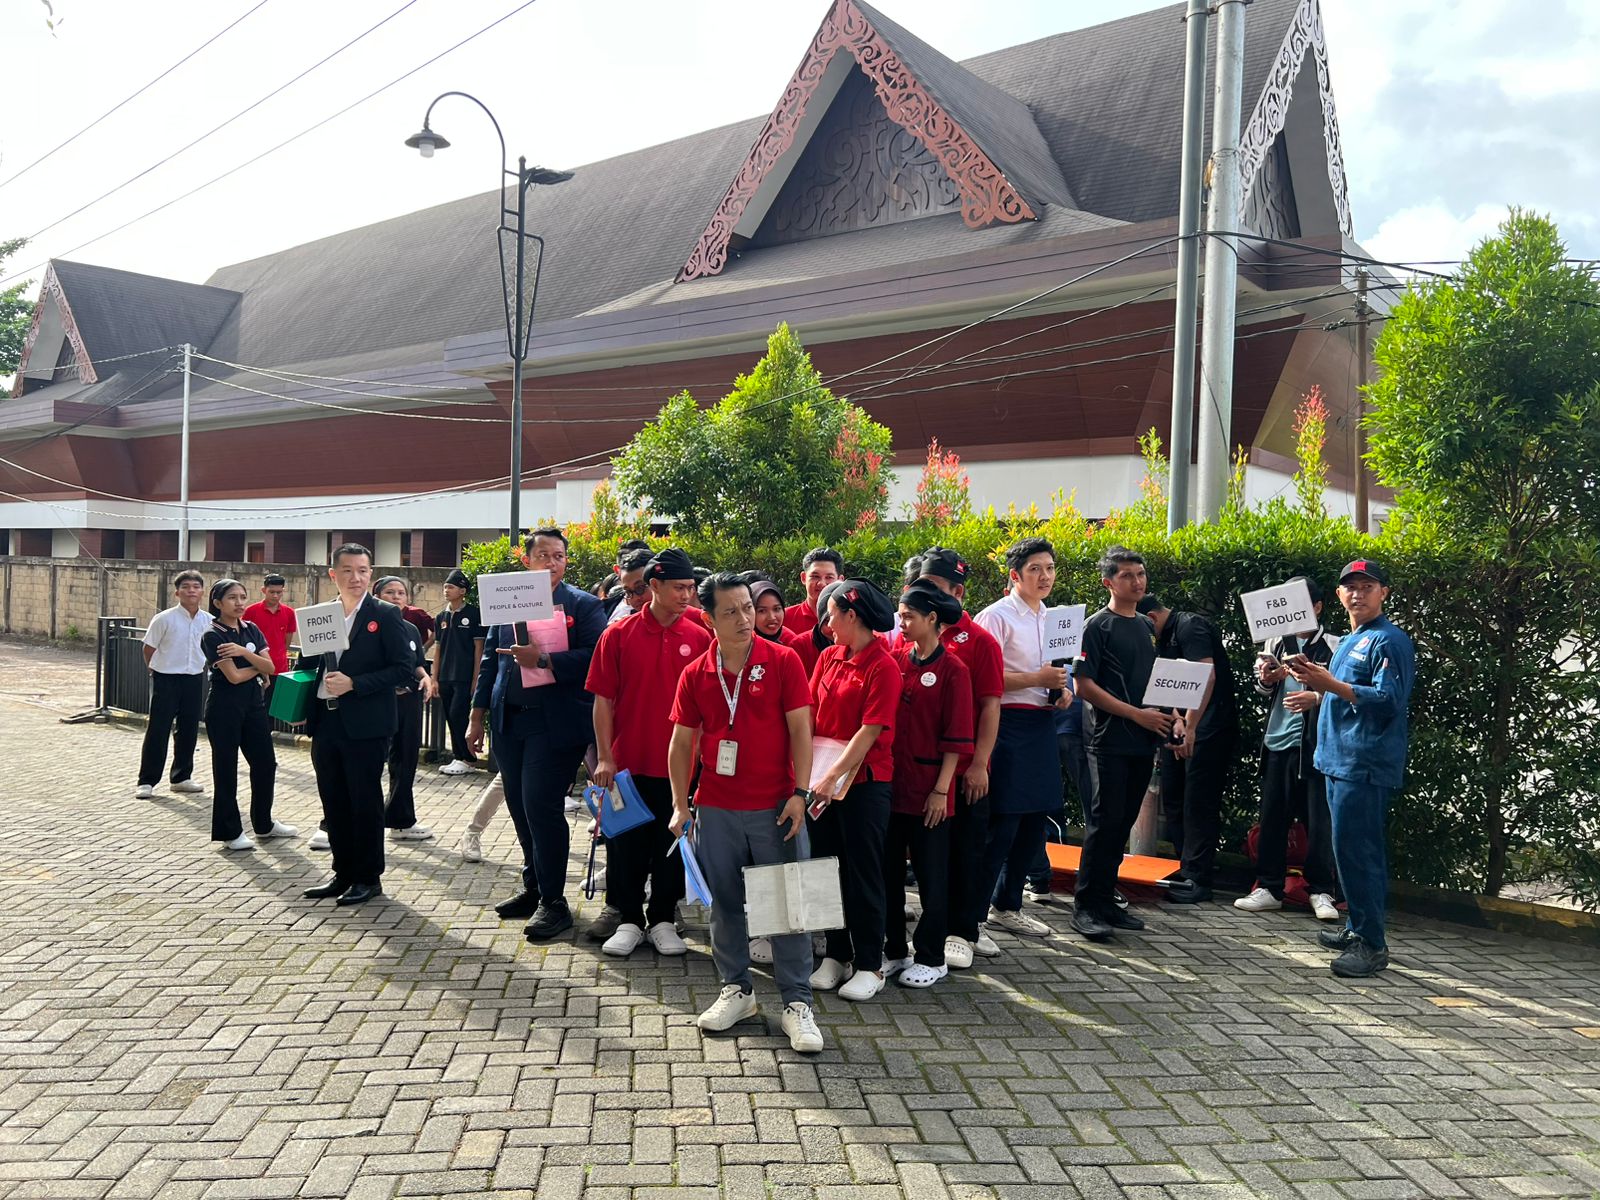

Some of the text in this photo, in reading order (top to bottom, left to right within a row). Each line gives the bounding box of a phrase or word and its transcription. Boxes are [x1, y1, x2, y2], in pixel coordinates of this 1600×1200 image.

[495, 584, 535, 592] ACCOUNTING
[489, 603, 512, 611] PEOPLE
[517, 601, 544, 609] CULTURE
[1265, 597, 1288, 609] F&B
[306, 614, 333, 627] FRONT
[1057, 619, 1072, 630] F&B
[1255, 610, 1307, 629] PRODUCT
[308, 630, 337, 643] OFFICE
[1048, 635, 1077, 649] SERVICE
[1154, 678, 1201, 691] SECURITY
